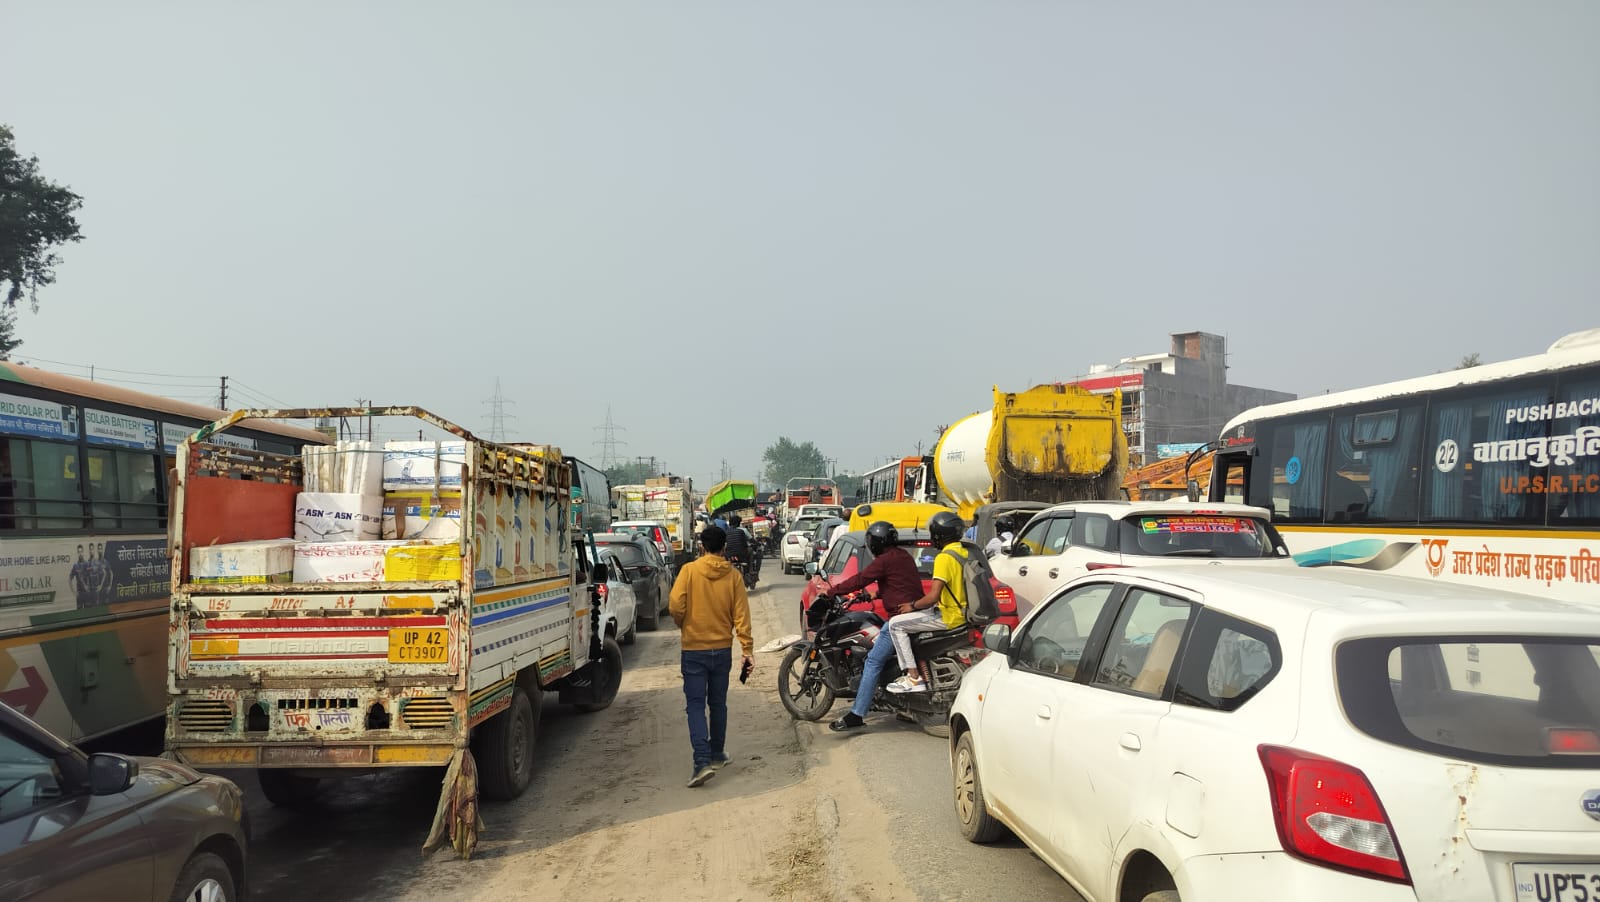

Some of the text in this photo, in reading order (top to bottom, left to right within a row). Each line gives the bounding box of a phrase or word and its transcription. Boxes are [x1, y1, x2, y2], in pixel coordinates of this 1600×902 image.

[17, 404, 43, 418] SOLAR
[45, 408, 60, 420] PCU
[1505, 397, 1600, 424] PUSH BACK
[85, 411, 144, 431] SOLAR BATTERY
[305, 508, 325, 518] ASN
[334, 512, 352, 521] ASN
[14, 556, 35, 566] HOME
[36, 555, 50, 565] LIKE
[57, 554, 71, 564] PRO
[117, 545, 137, 561] सोलर
[137, 544, 158, 560] सिस्टम
[1452, 550, 1474, 575] उत्तर
[1475, 544, 1501, 577] प्रदेश
[1504, 553, 1531, 579] राज्य
[1534, 554, 1567, 588] सड़क
[15, 575, 52, 591] SOLAR
[338, 573, 358, 583] SFC
[139, 583, 148, 594] का
[404, 631, 441, 645] UP 42
[399, 646, 445, 659] CT3907
[1518, 872, 1600, 902] IND UP53
